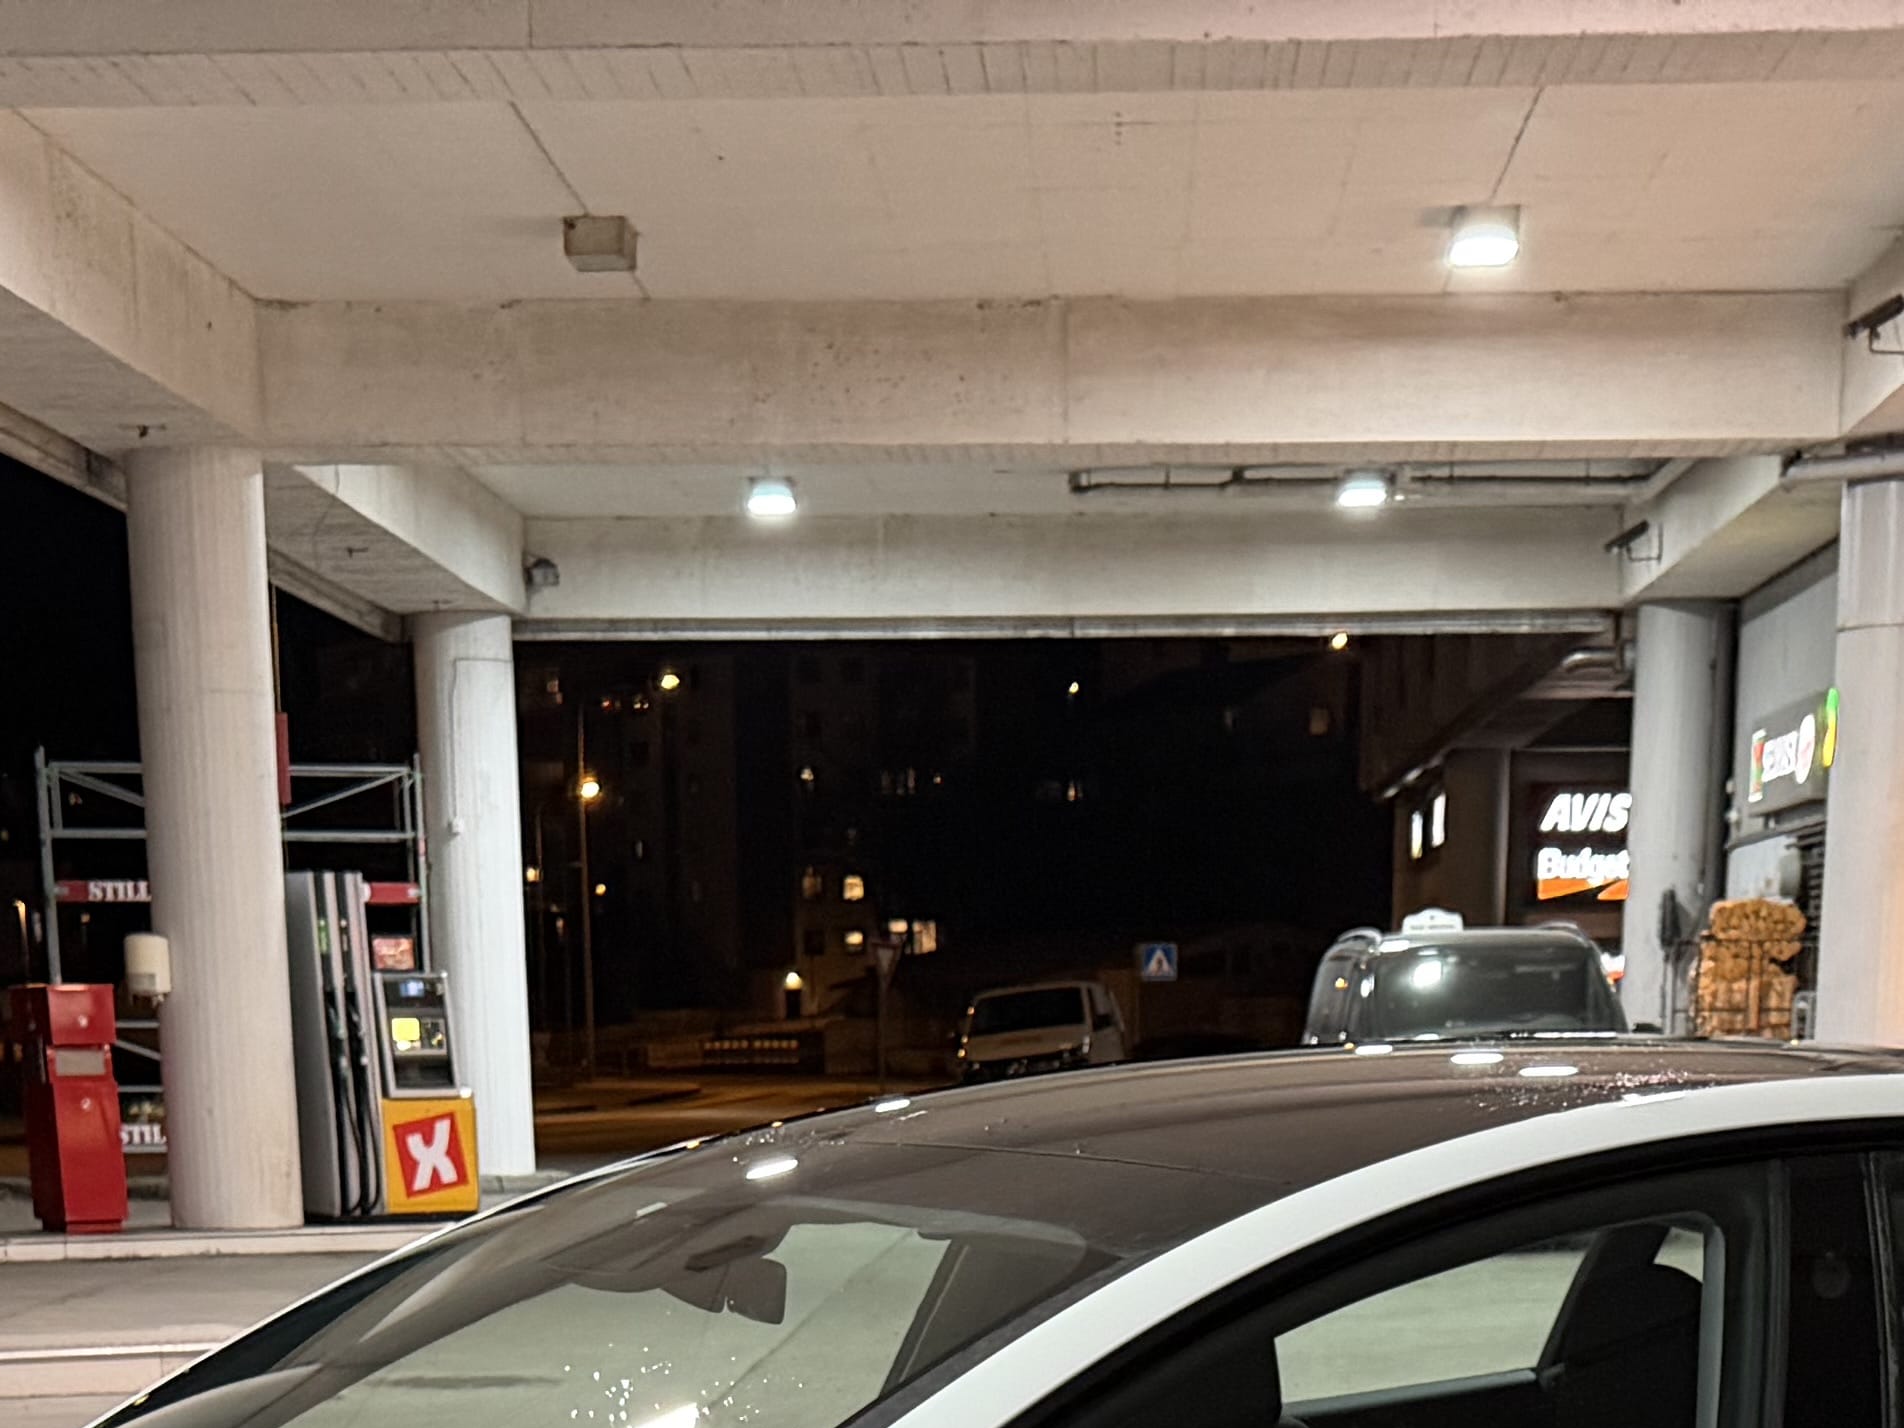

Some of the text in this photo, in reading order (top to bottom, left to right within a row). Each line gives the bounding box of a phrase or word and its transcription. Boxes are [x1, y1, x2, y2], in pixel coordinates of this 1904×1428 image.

[1538, 792, 1633, 832] AVIS
[1536, 847, 1630, 886] Budget
[87, 878, 152, 902] STILL
